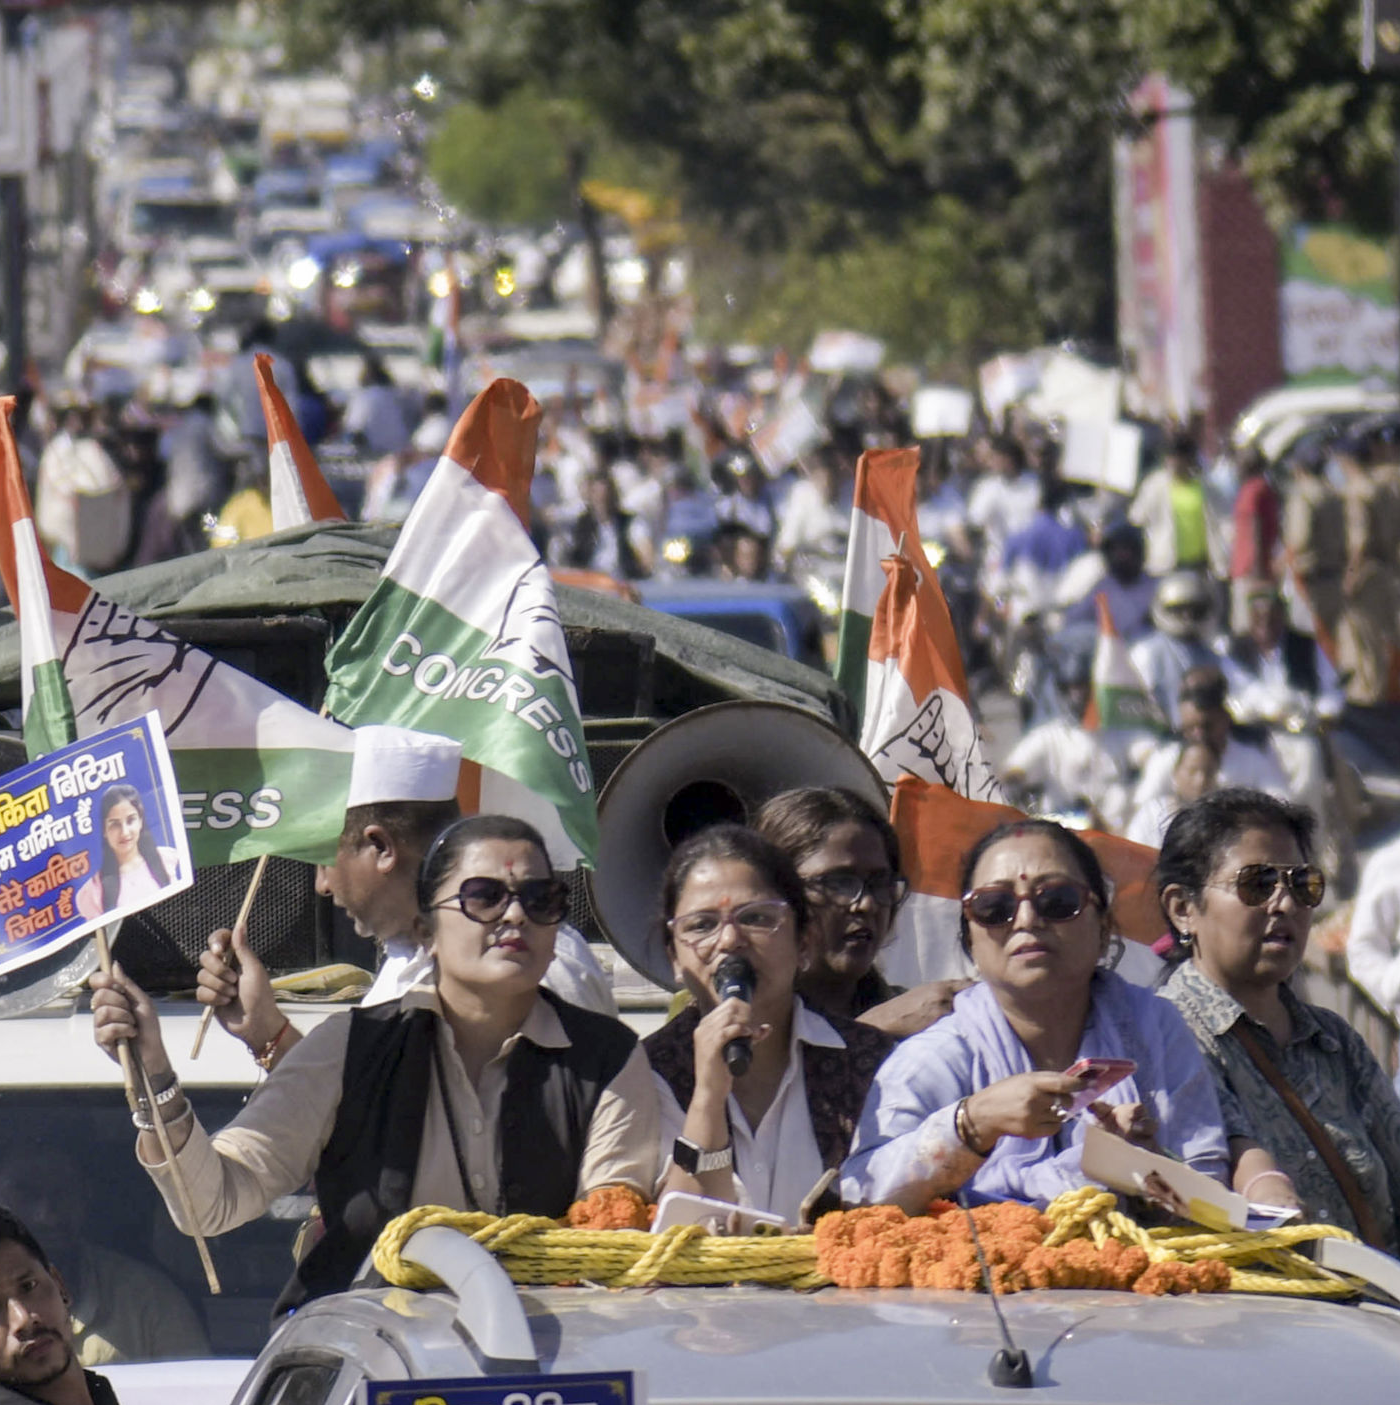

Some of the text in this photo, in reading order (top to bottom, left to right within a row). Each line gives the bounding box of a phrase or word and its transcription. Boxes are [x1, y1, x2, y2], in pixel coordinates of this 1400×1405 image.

[382, 632, 592, 793] CONGRESS
[50, 752, 126, 804] बिटिया
[75, 797, 93, 834] हैं
[25, 850, 90, 900] कातिल
[5, 904, 55, 943] जिंदा
